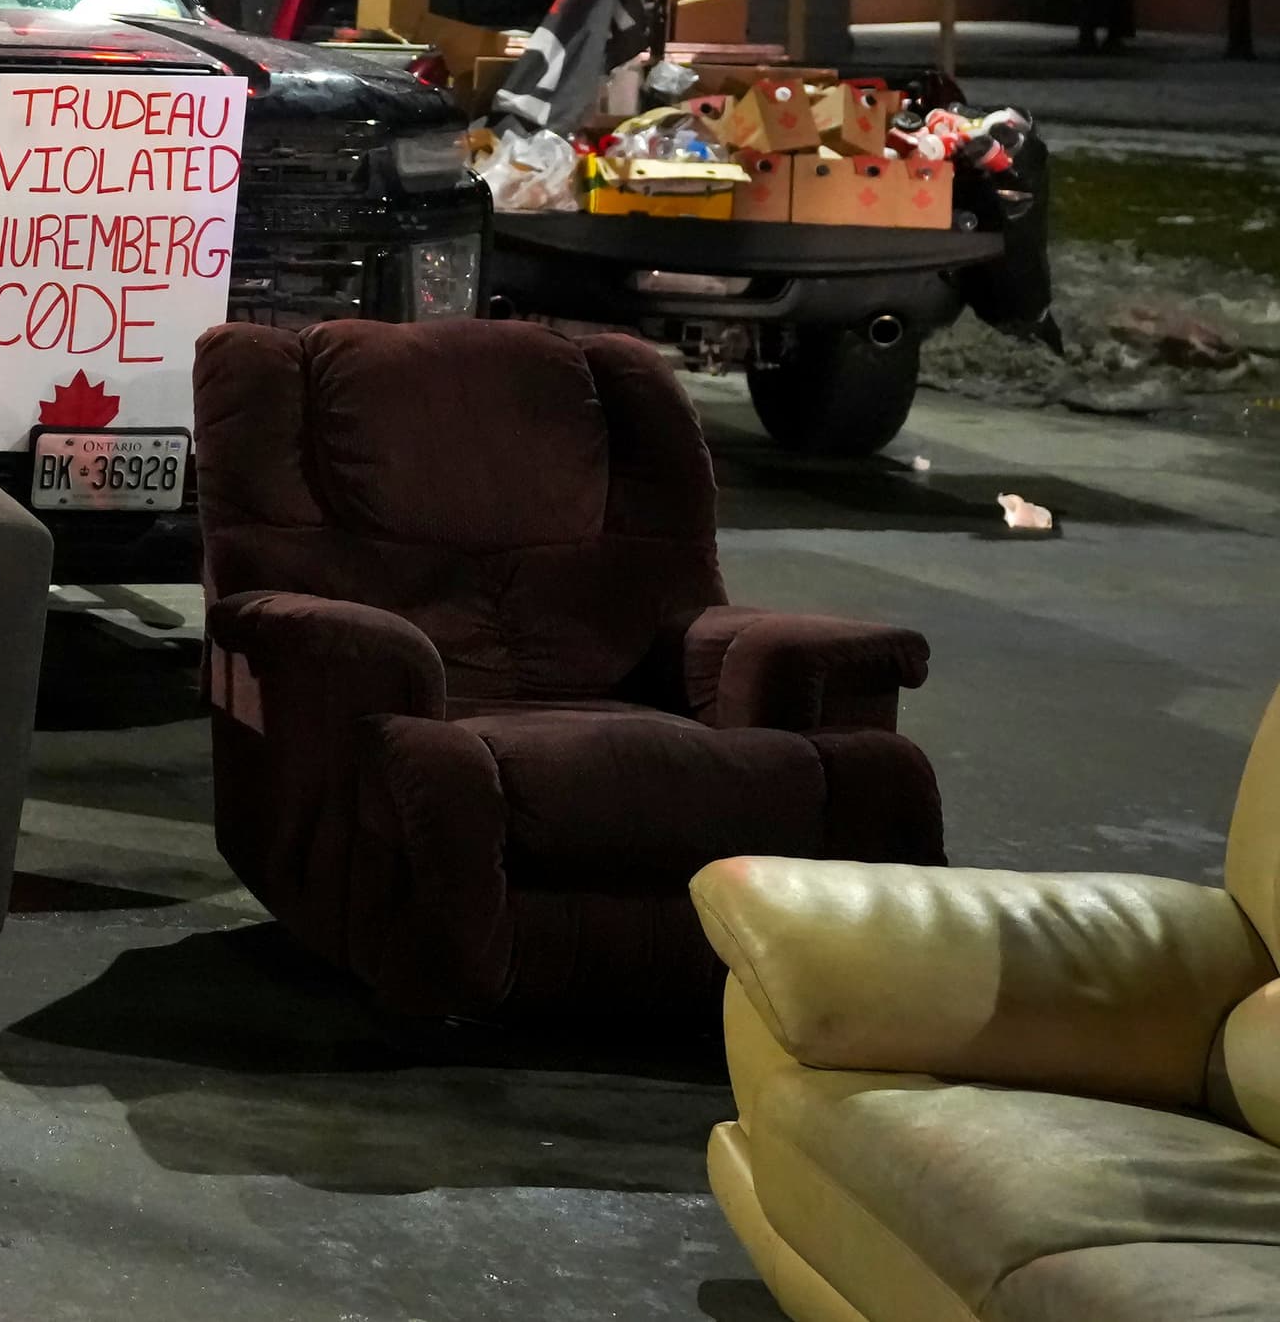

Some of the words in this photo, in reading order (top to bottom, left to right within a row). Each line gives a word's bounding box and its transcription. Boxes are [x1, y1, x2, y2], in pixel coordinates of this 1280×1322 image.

[12, 85, 230, 138] TRUDEAU
[83, 440, 143, 453] ONTARIO
[40, 454, 74, 490] BK
[91, 454, 178, 491] 36928
